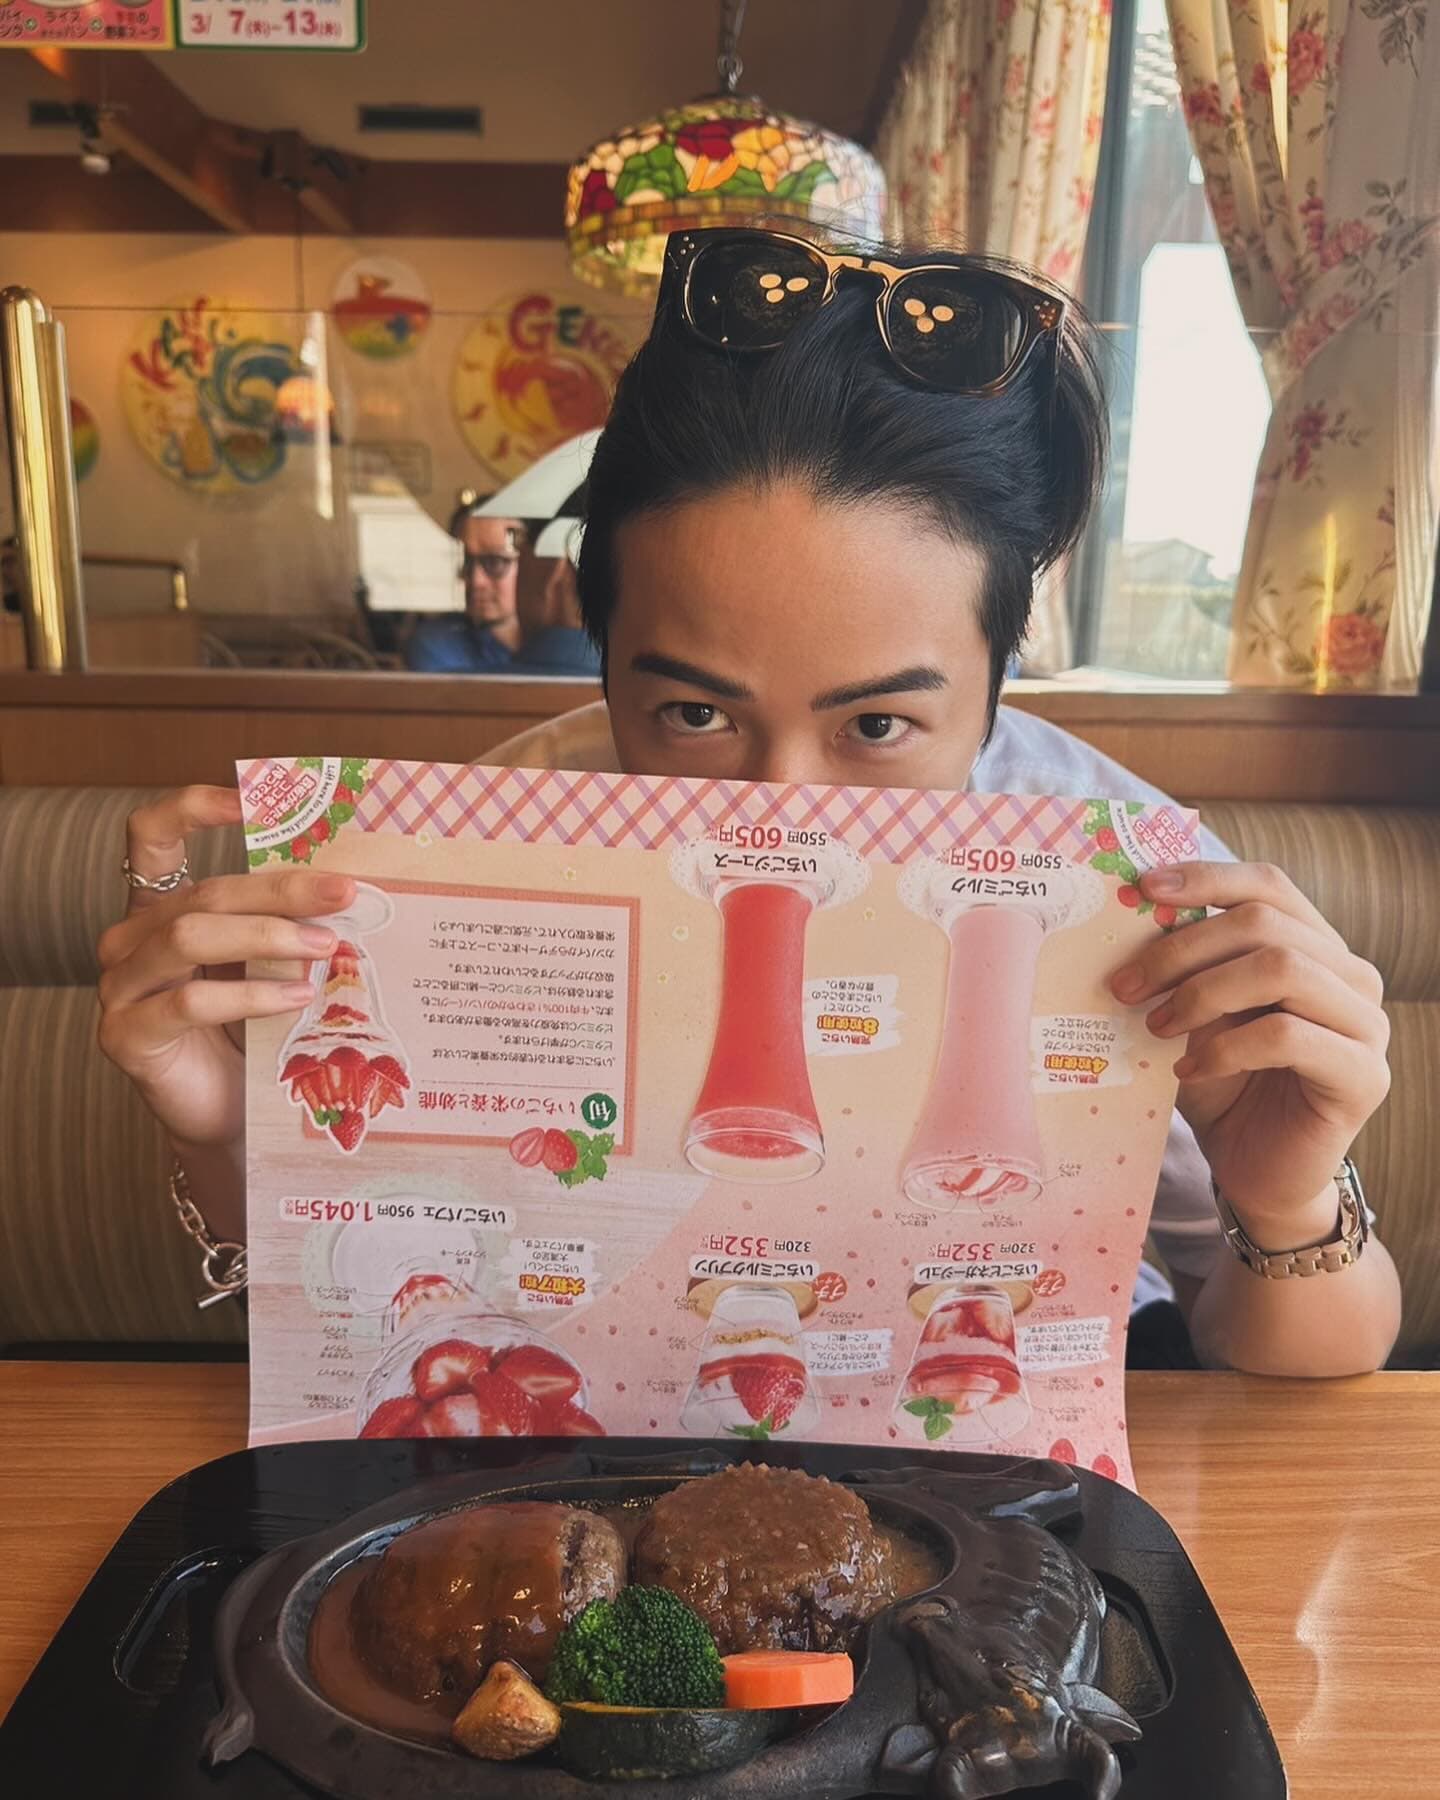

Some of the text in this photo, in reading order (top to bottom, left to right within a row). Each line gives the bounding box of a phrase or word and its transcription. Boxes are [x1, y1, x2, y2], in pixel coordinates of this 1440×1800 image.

[788, 831, 827, 845] 550円
[713, 853, 817, 873] いちごジュース
[1021, 854, 1063, 869] 550円
[951, 877, 1047, 896] いちごミルク
[448, 963, 615, 982] 吸収力がアップするといわれています。
[812, 991, 882, 1002] いちごまるごとの
[422, 1013, 613, 1033] ビタミンCは免疫力を高める働きがあります。
[817, 1016, 879, 1035] 8粒使用!
[498, 1035, 613, 1049] ビタミンCが挙げられます。
[821, 1034, 871, 1045] 完熟いちご
[432, 1049, 614, 1067] いちごに含まれる代表的な栄養素といえば
[1044, 1054, 1108, 1074] 4粒使用!
[1048, 1074, 1099, 1084] 完熟いちご
[418, 1091, 610, 1120] 旬 いちごの栄養と効能
[377, 1204, 415, 1218] 950円
[423, 1207, 506, 1225] いちごパフェ
[775, 1240, 811, 1253] 320円
[1000, 1243, 1036, 1254] 320円
[694, 1259, 814, 1276] いちごミルクプリン
[919, 1263, 1038, 1279] いちごビネガージュレ
